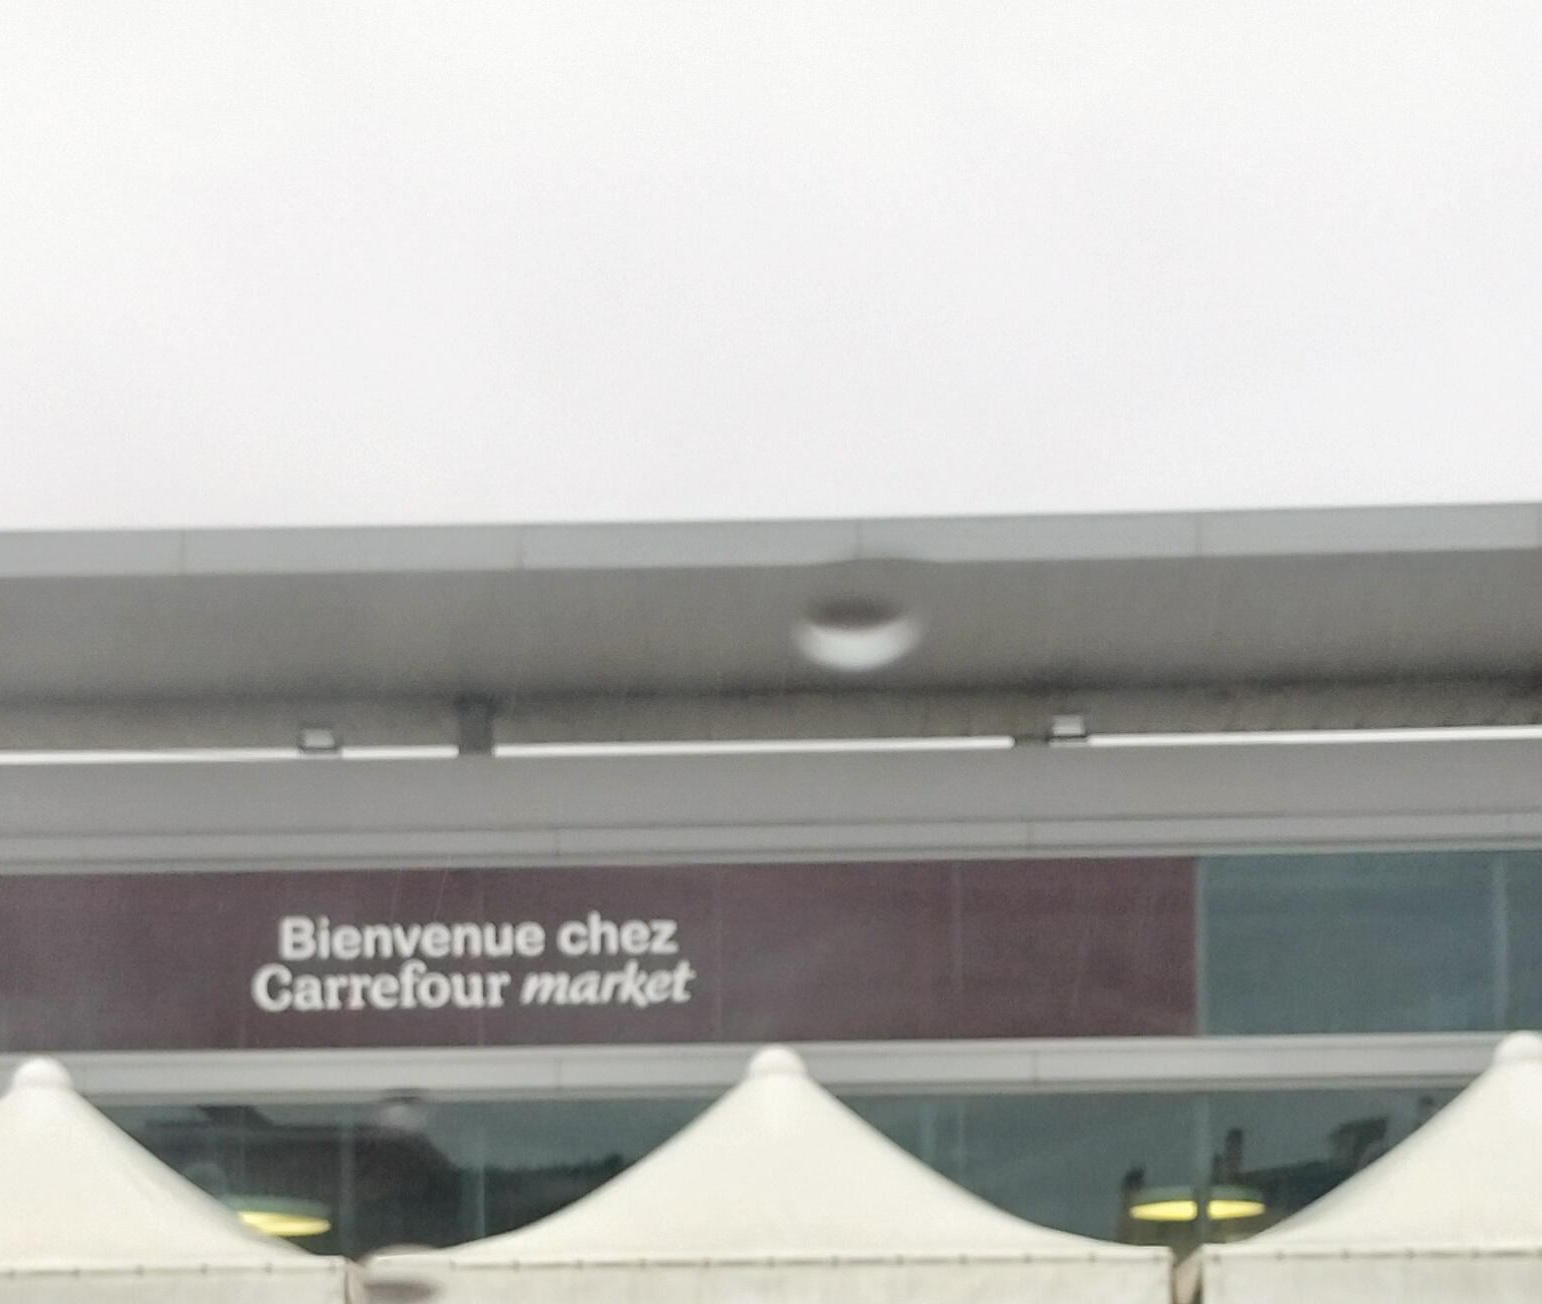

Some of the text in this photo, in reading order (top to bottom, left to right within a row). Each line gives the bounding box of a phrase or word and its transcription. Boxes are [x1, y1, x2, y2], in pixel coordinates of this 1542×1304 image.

[279, 912, 678, 959] Bienvenue chez
[253, 961, 695, 1011] Carrefour market
